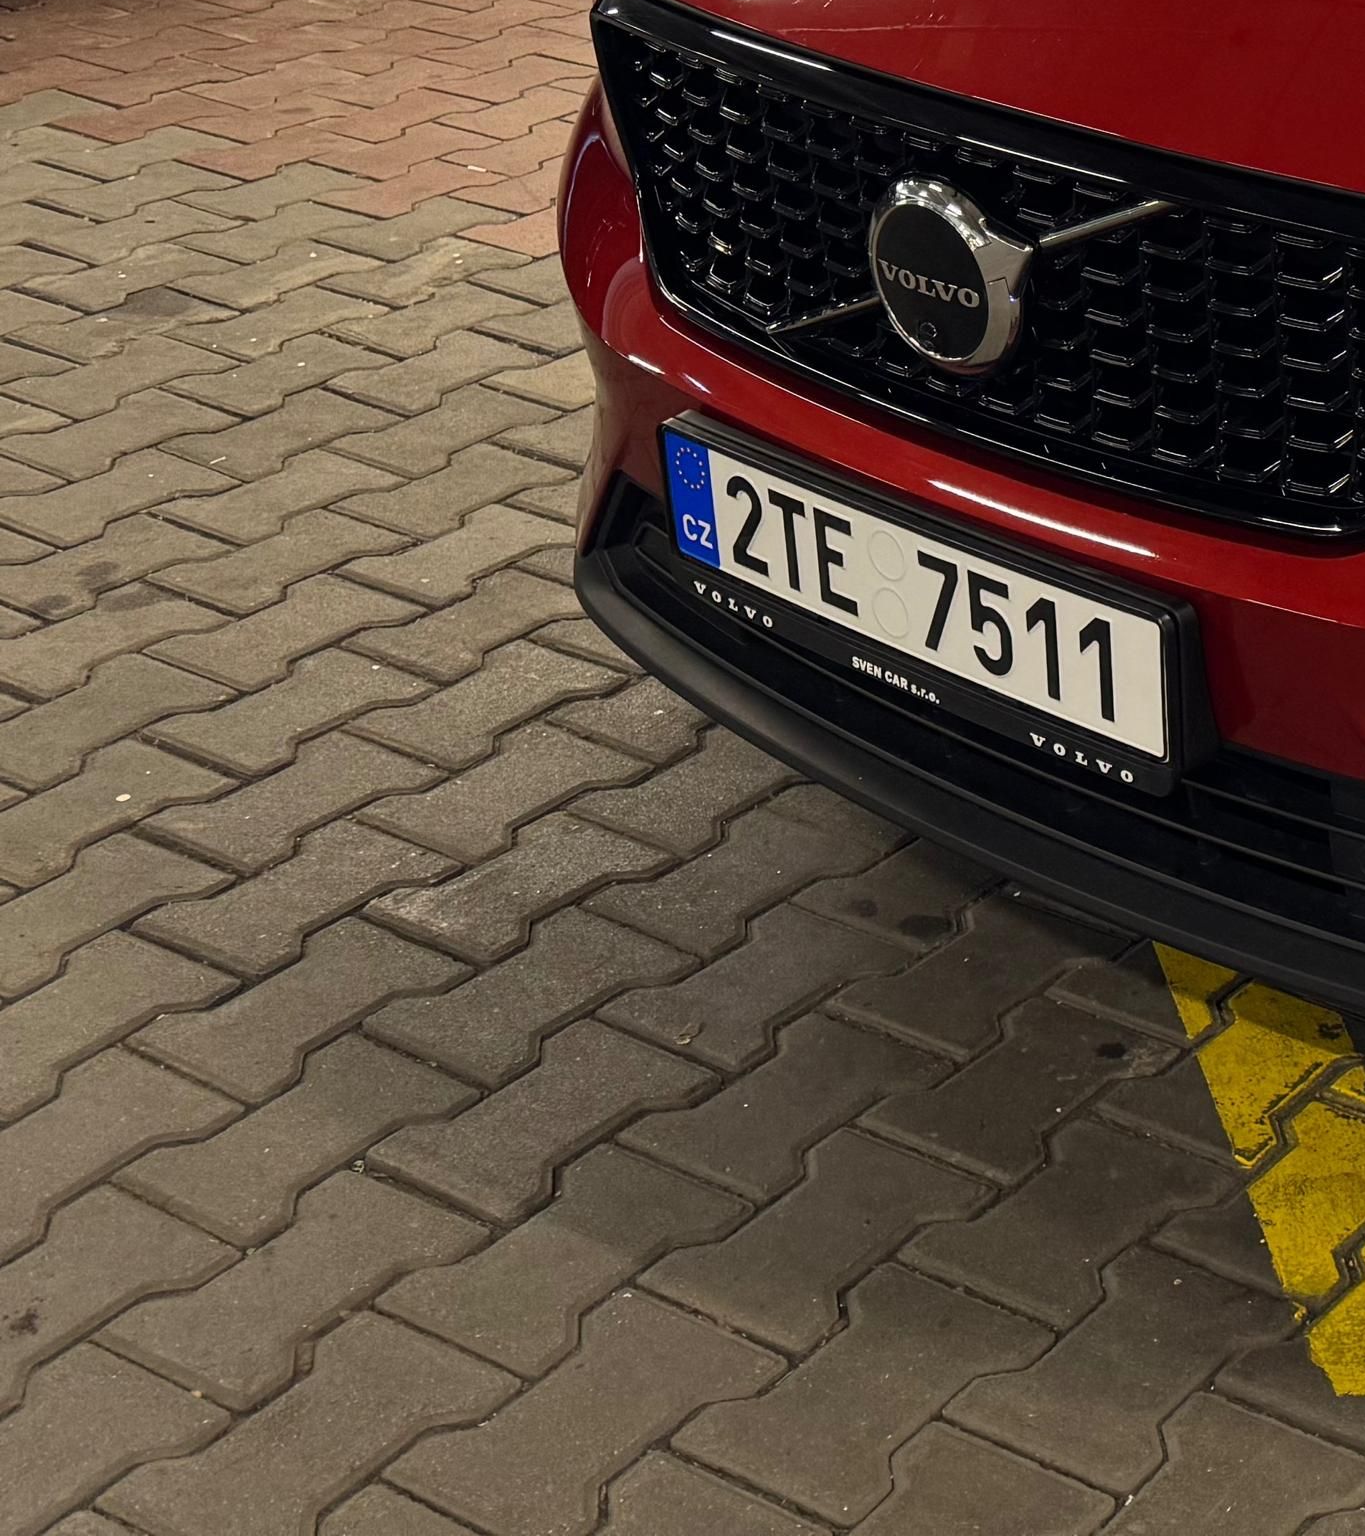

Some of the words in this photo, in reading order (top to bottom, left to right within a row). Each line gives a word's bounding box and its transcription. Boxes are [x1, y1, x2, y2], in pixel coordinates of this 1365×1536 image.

[878, 258, 980, 308] VOLVO
[682, 513, 714, 549] CZ
[694, 580, 774, 628] VOLVO
[726, 475, 859, 617] 2TE
[917, 549, 1115, 723] 7511
[852, 655, 882, 680] SVEN
[884, 671, 909, 691] CAR
[911, 683, 941, 705] s.r.o.
[1029, 732, 1134, 783] VOLVO
